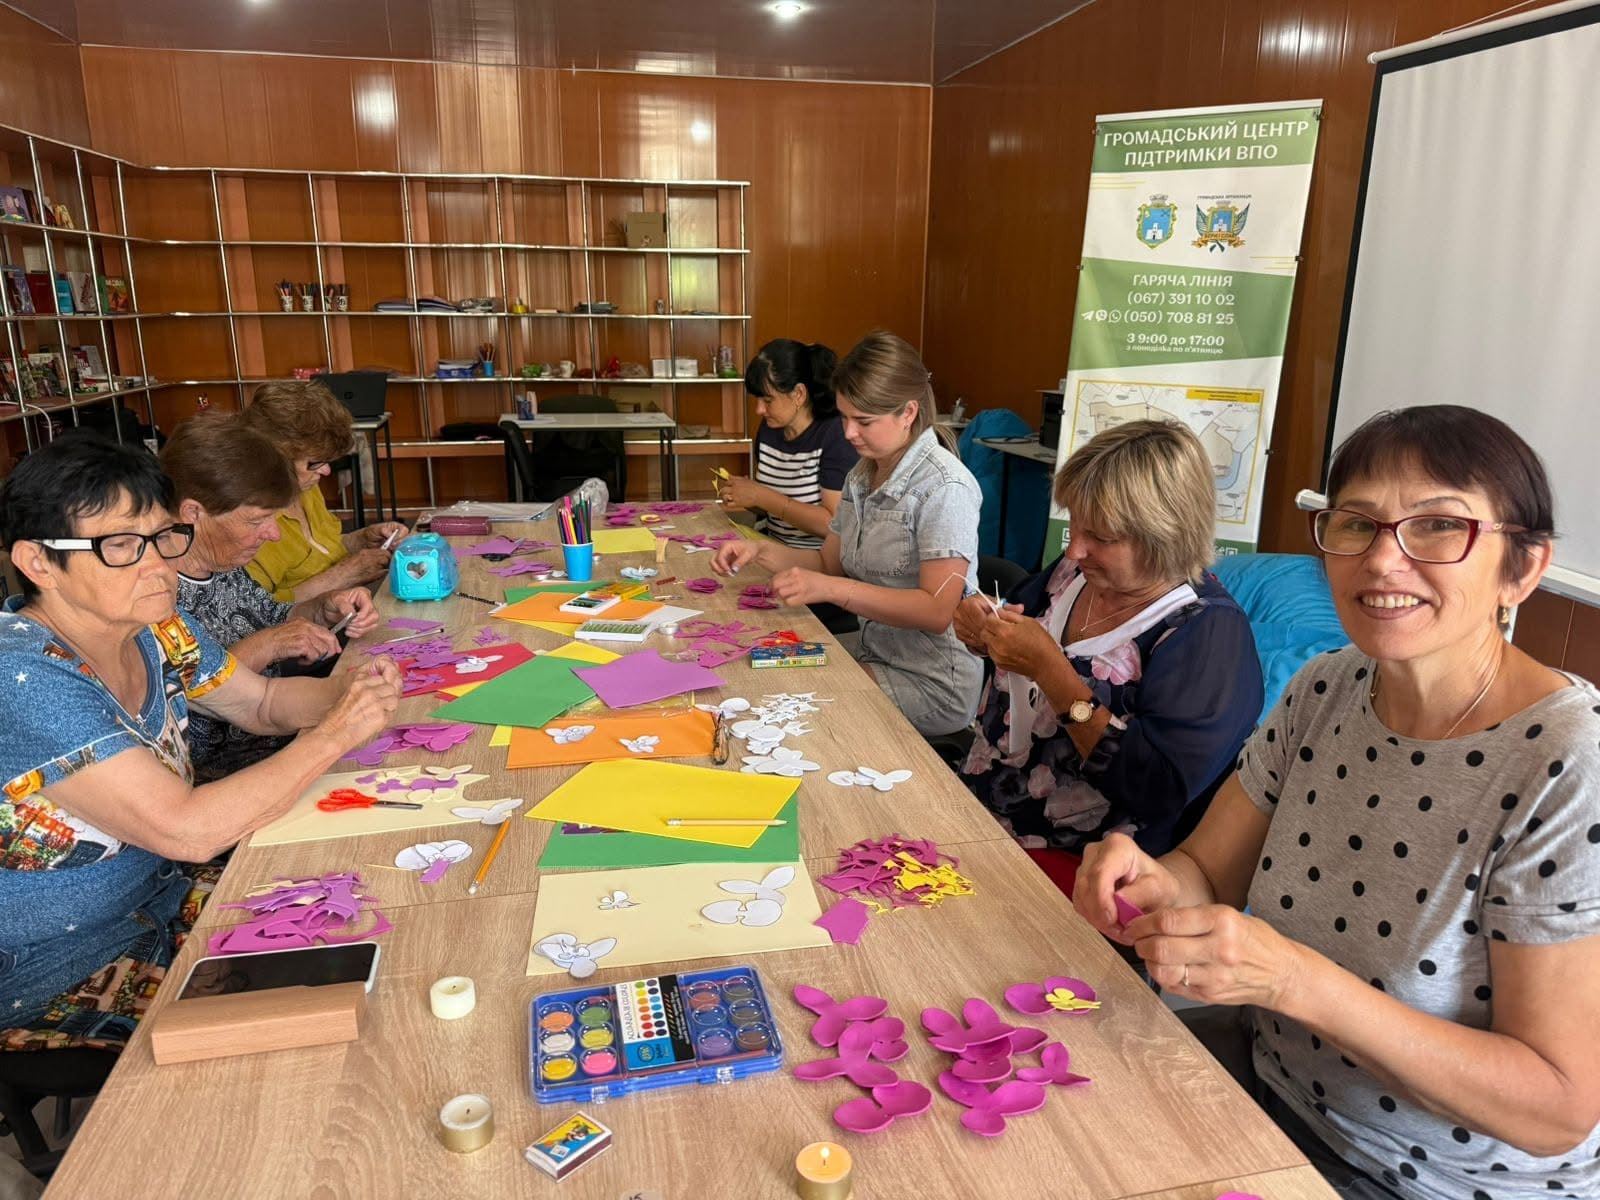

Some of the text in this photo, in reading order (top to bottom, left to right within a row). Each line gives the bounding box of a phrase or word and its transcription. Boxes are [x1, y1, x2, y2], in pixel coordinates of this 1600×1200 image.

[1103, 120, 1309, 147] ГРОМАДСЬКИЙ ЦЕНТР
[1124, 144, 1278, 167] ПІДТРИМКИ ВПО
[1132, 275, 1233, 287] ГАРЯЧА ЛІНІЯ
[1127, 292, 1235, 306] (067) 391 10 02
[1124, 309, 1235, 325] (050) 708 81 25
[1137, 333, 1167, 344] 9:00
[1169, 336, 1186, 346] до
[1189, 335, 1225, 346] 17:00
